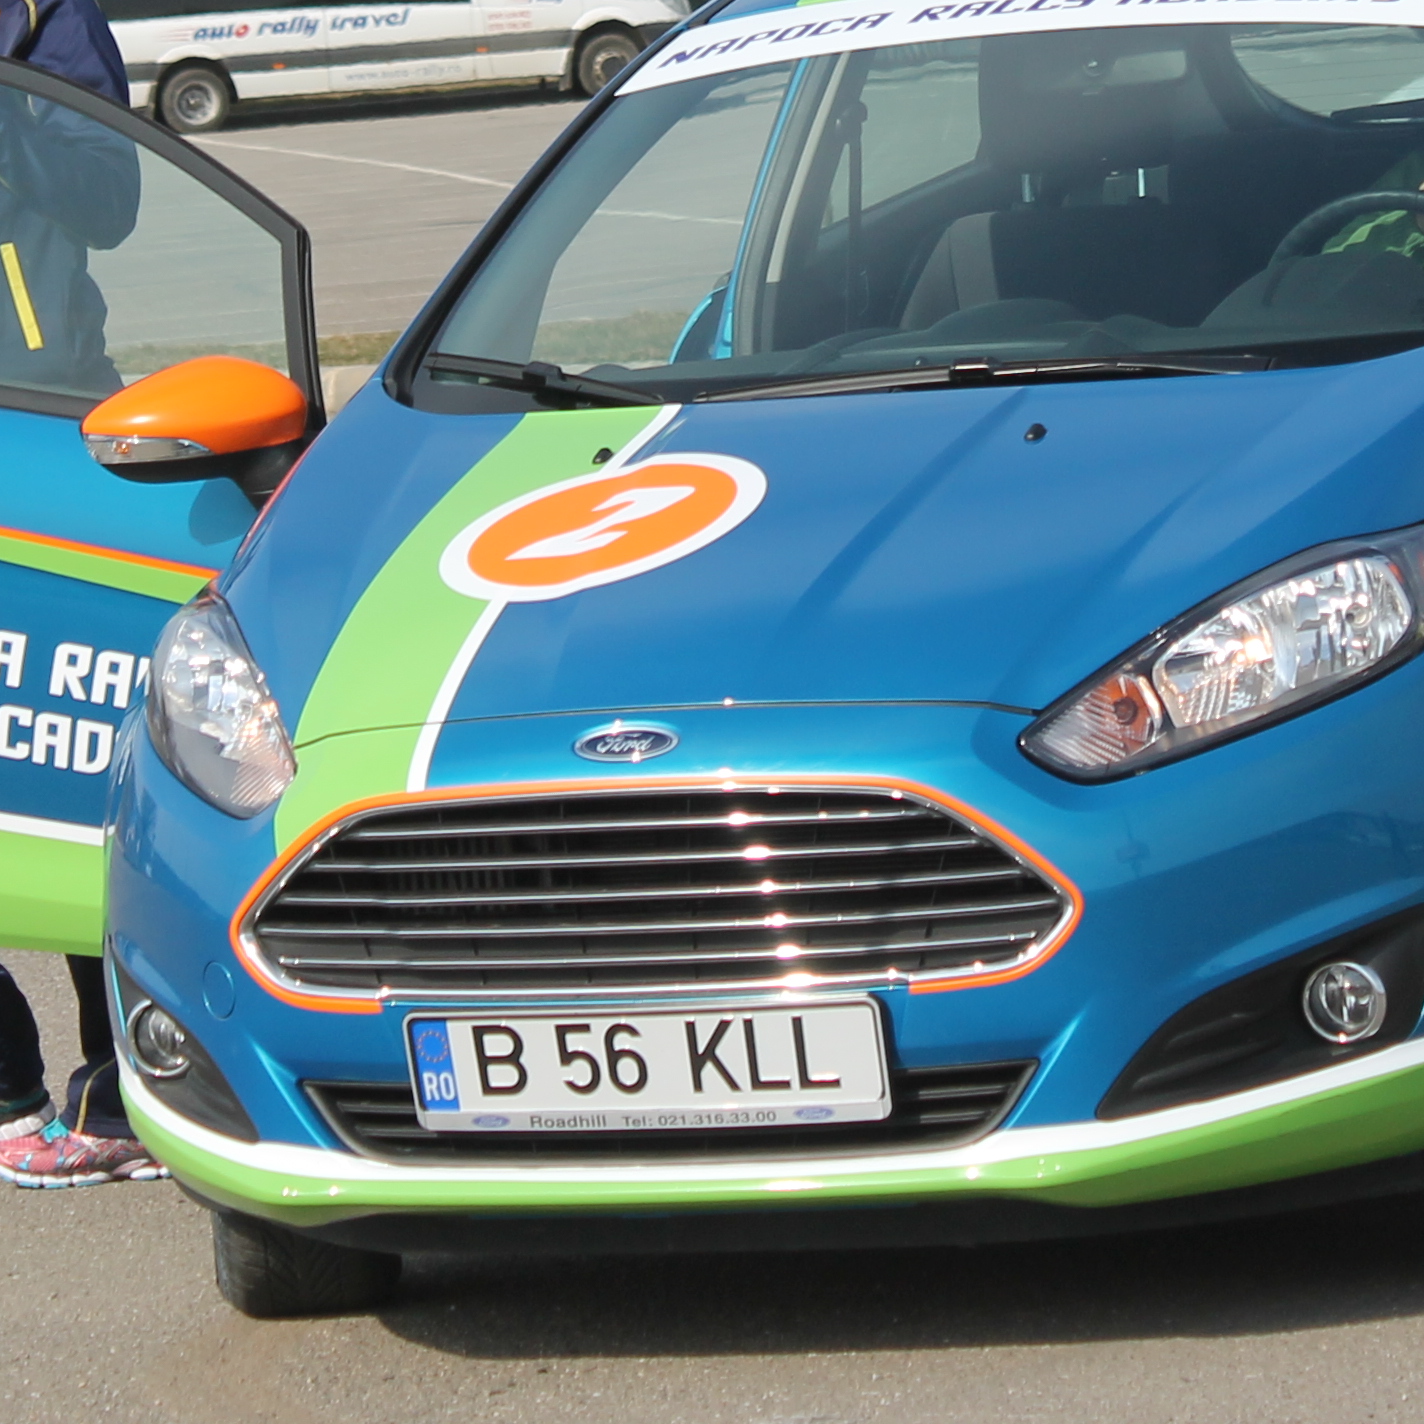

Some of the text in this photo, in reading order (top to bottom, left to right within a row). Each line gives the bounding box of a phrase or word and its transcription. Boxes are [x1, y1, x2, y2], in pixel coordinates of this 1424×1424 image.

[257, 15, 320, 38] rally
[657, 10, 895, 69] NAPOCA
[470, 1014, 842, 1098] B 56 KLL
[424, 1072, 456, 1102] RO
[529, 1109, 777, 1130] Roadhill Tel: 021.316.33.00
